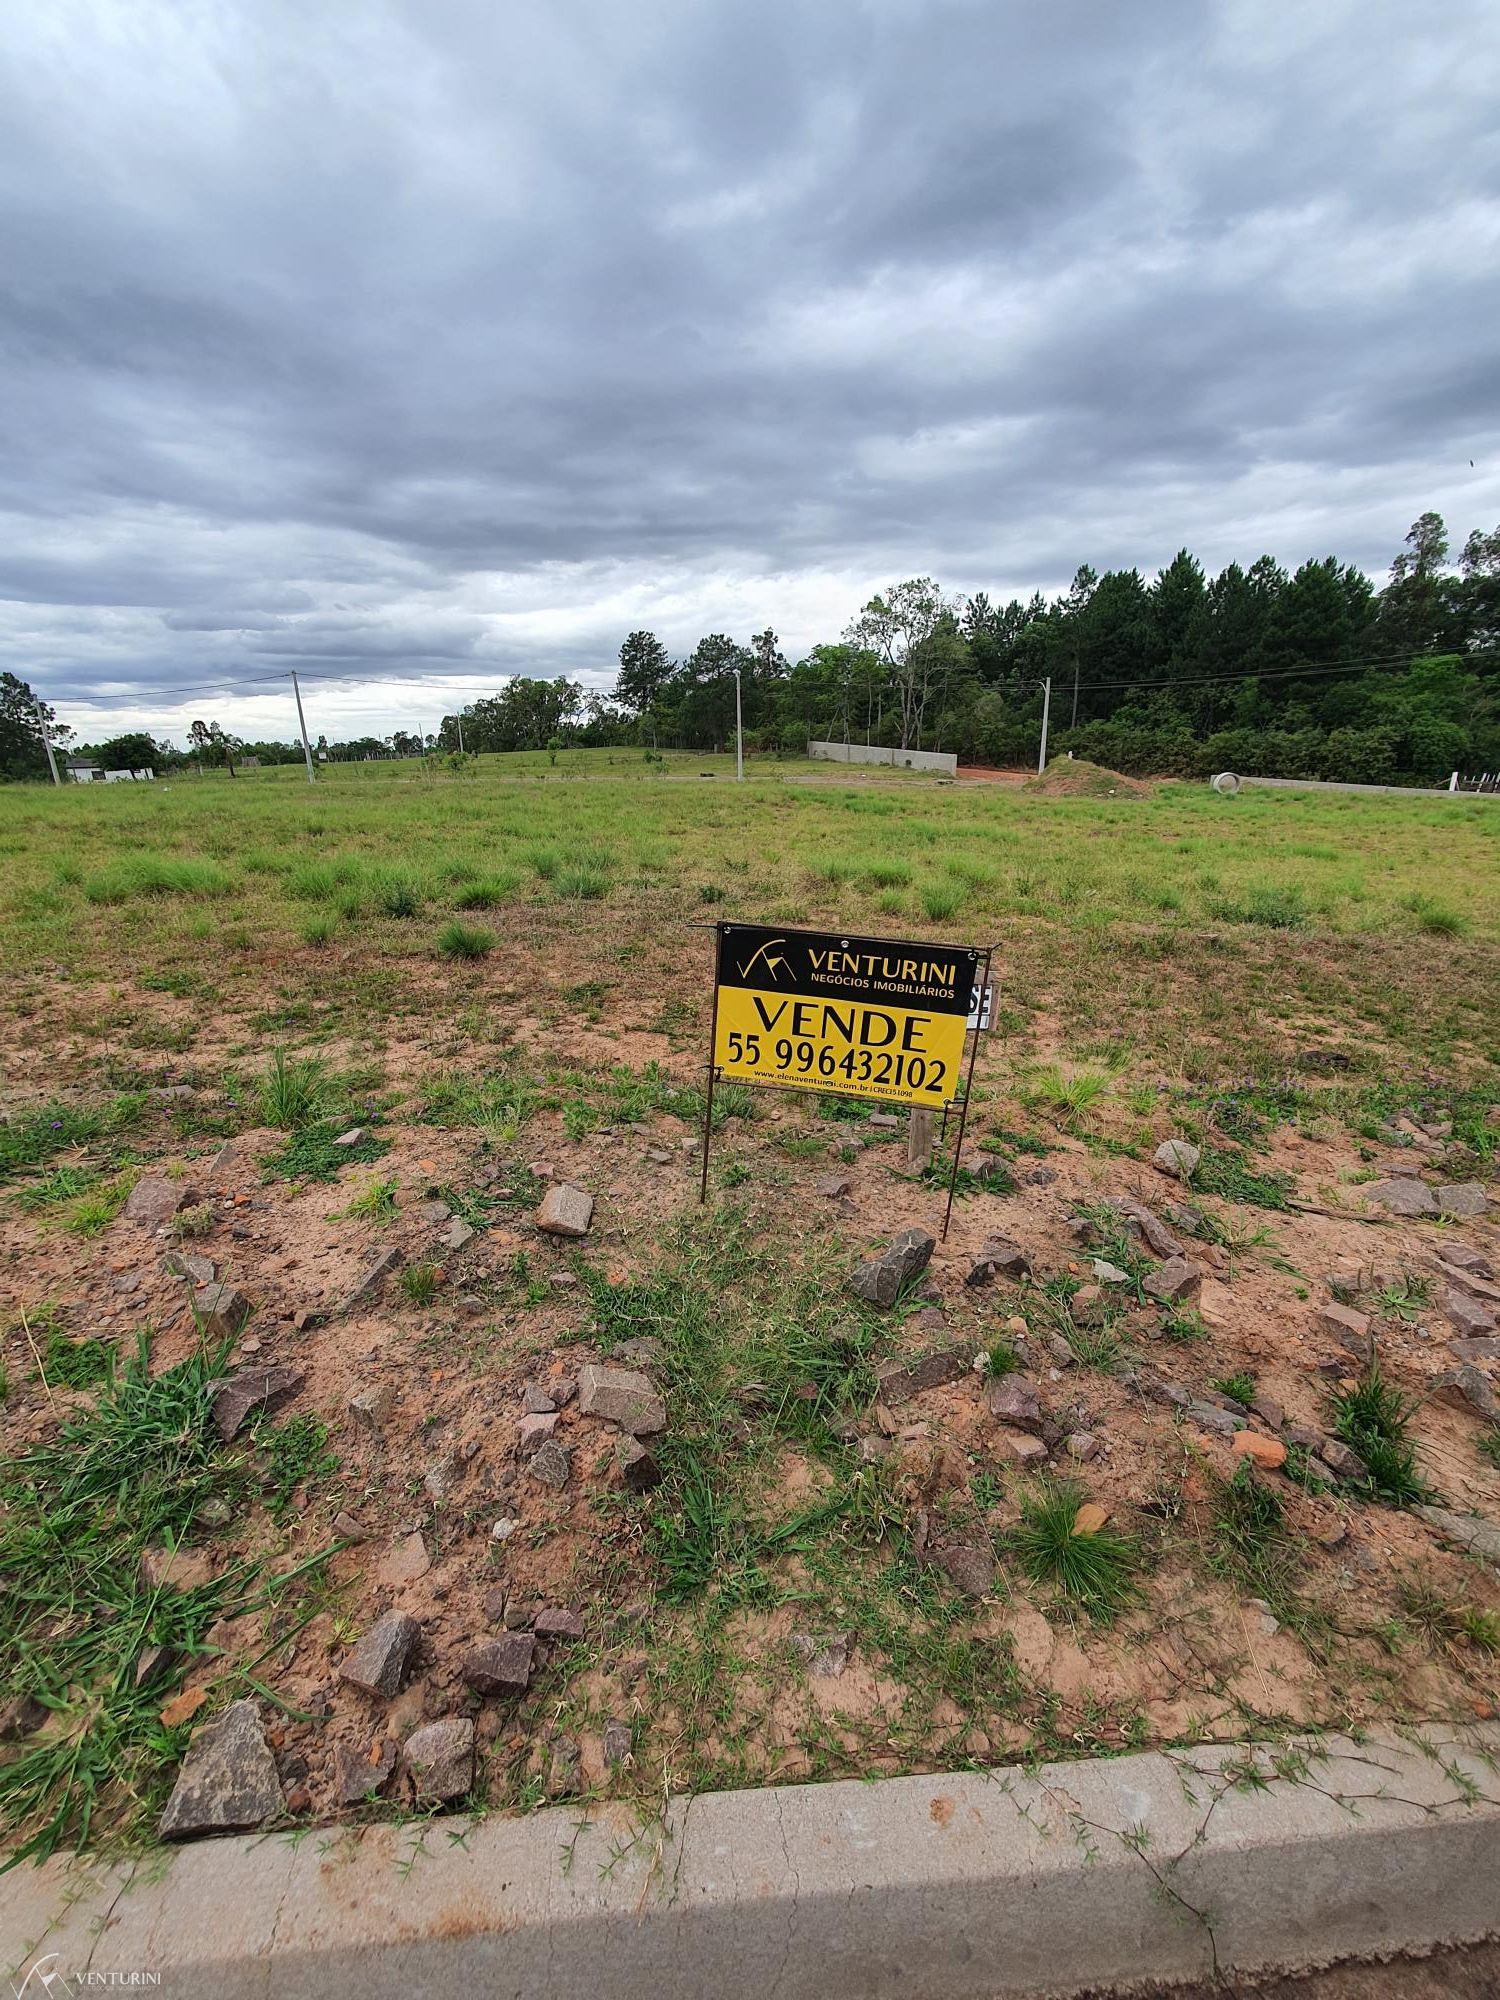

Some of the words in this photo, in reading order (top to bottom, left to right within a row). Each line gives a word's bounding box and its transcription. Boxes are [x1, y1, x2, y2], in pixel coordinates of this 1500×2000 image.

[808, 948, 956, 986] VENTURINI
[811, 972, 870, 989] NEGÓCIOS
[873, 979, 955, 999] IMOBILIÁRIOS
[752, 996, 932, 1053] VENDE
[728, 1032, 761, 1066] 55
[775, 1038, 947, 1093] 996432102
